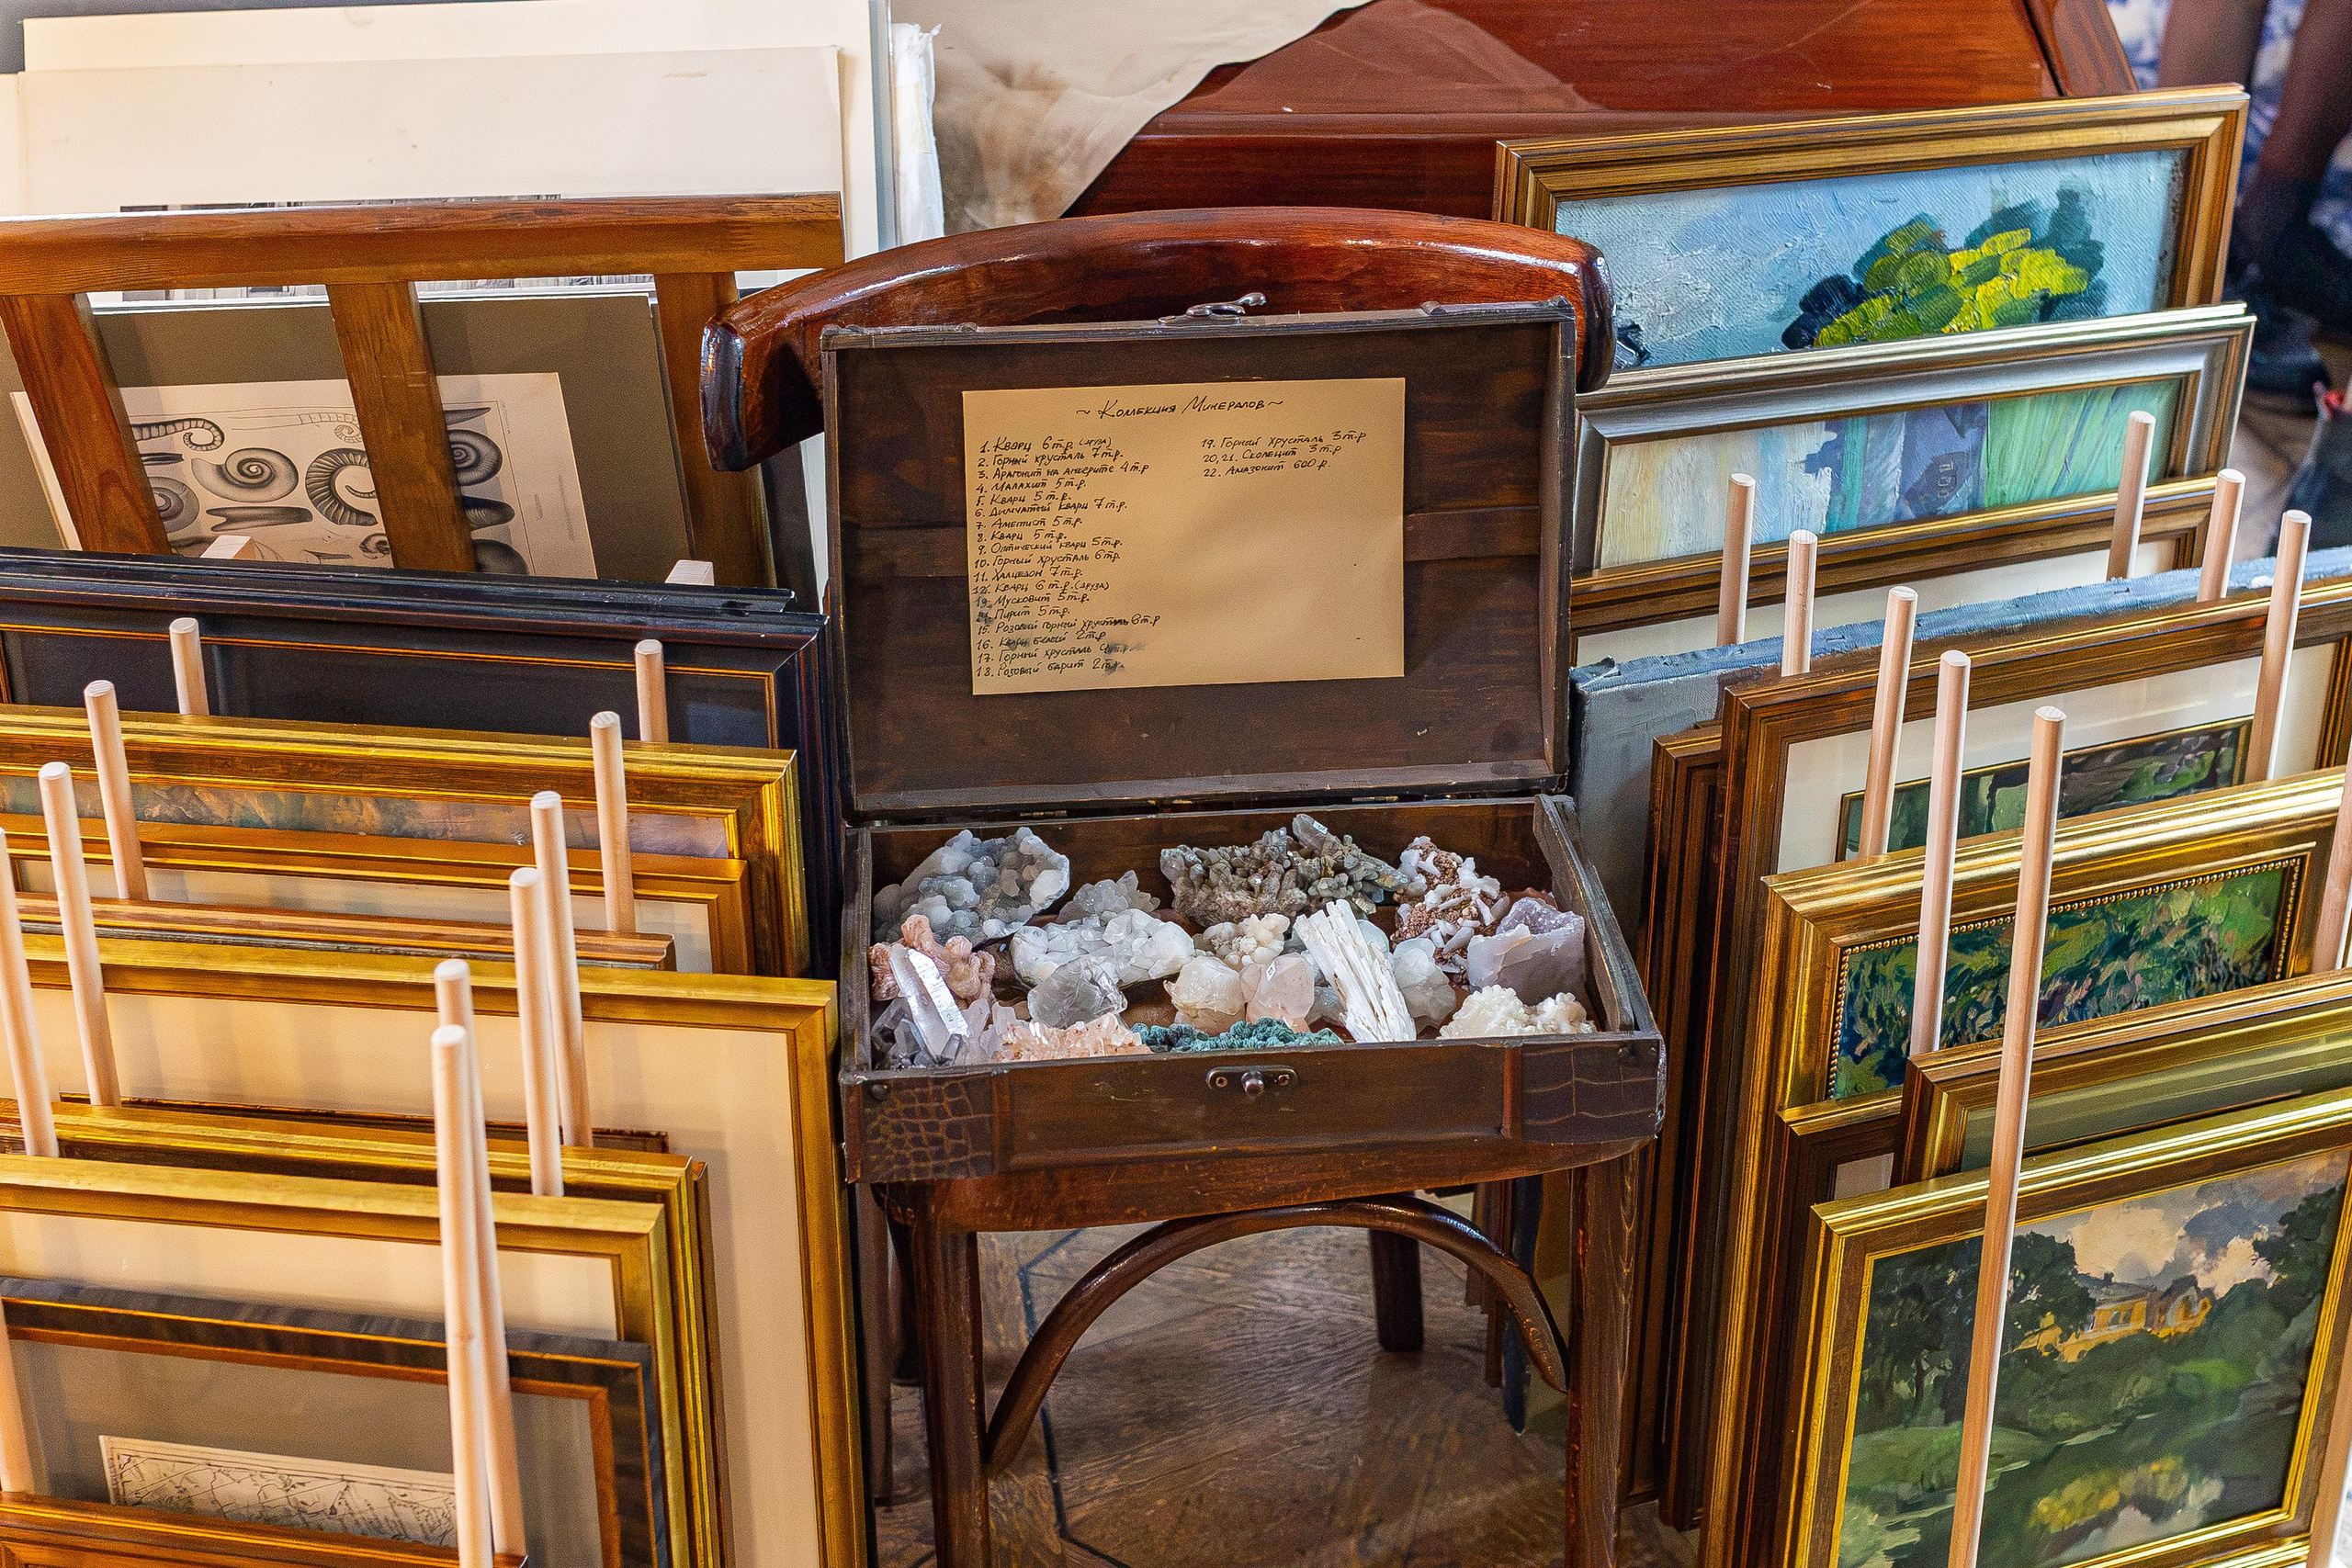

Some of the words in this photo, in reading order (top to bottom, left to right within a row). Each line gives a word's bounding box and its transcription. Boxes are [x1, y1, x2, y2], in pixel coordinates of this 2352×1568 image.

[1202, 438, 1216, 449] 19.
[978, 457, 989, 468] 2.
[1204, 468, 1221, 478] 22.
[975, 508, 986, 518] 6.
[974, 558, 989, 569] 10.
[976, 641, 993, 650] 16.
[978, 653, 994, 663] 17.
[976, 666, 994, 678] 18.
